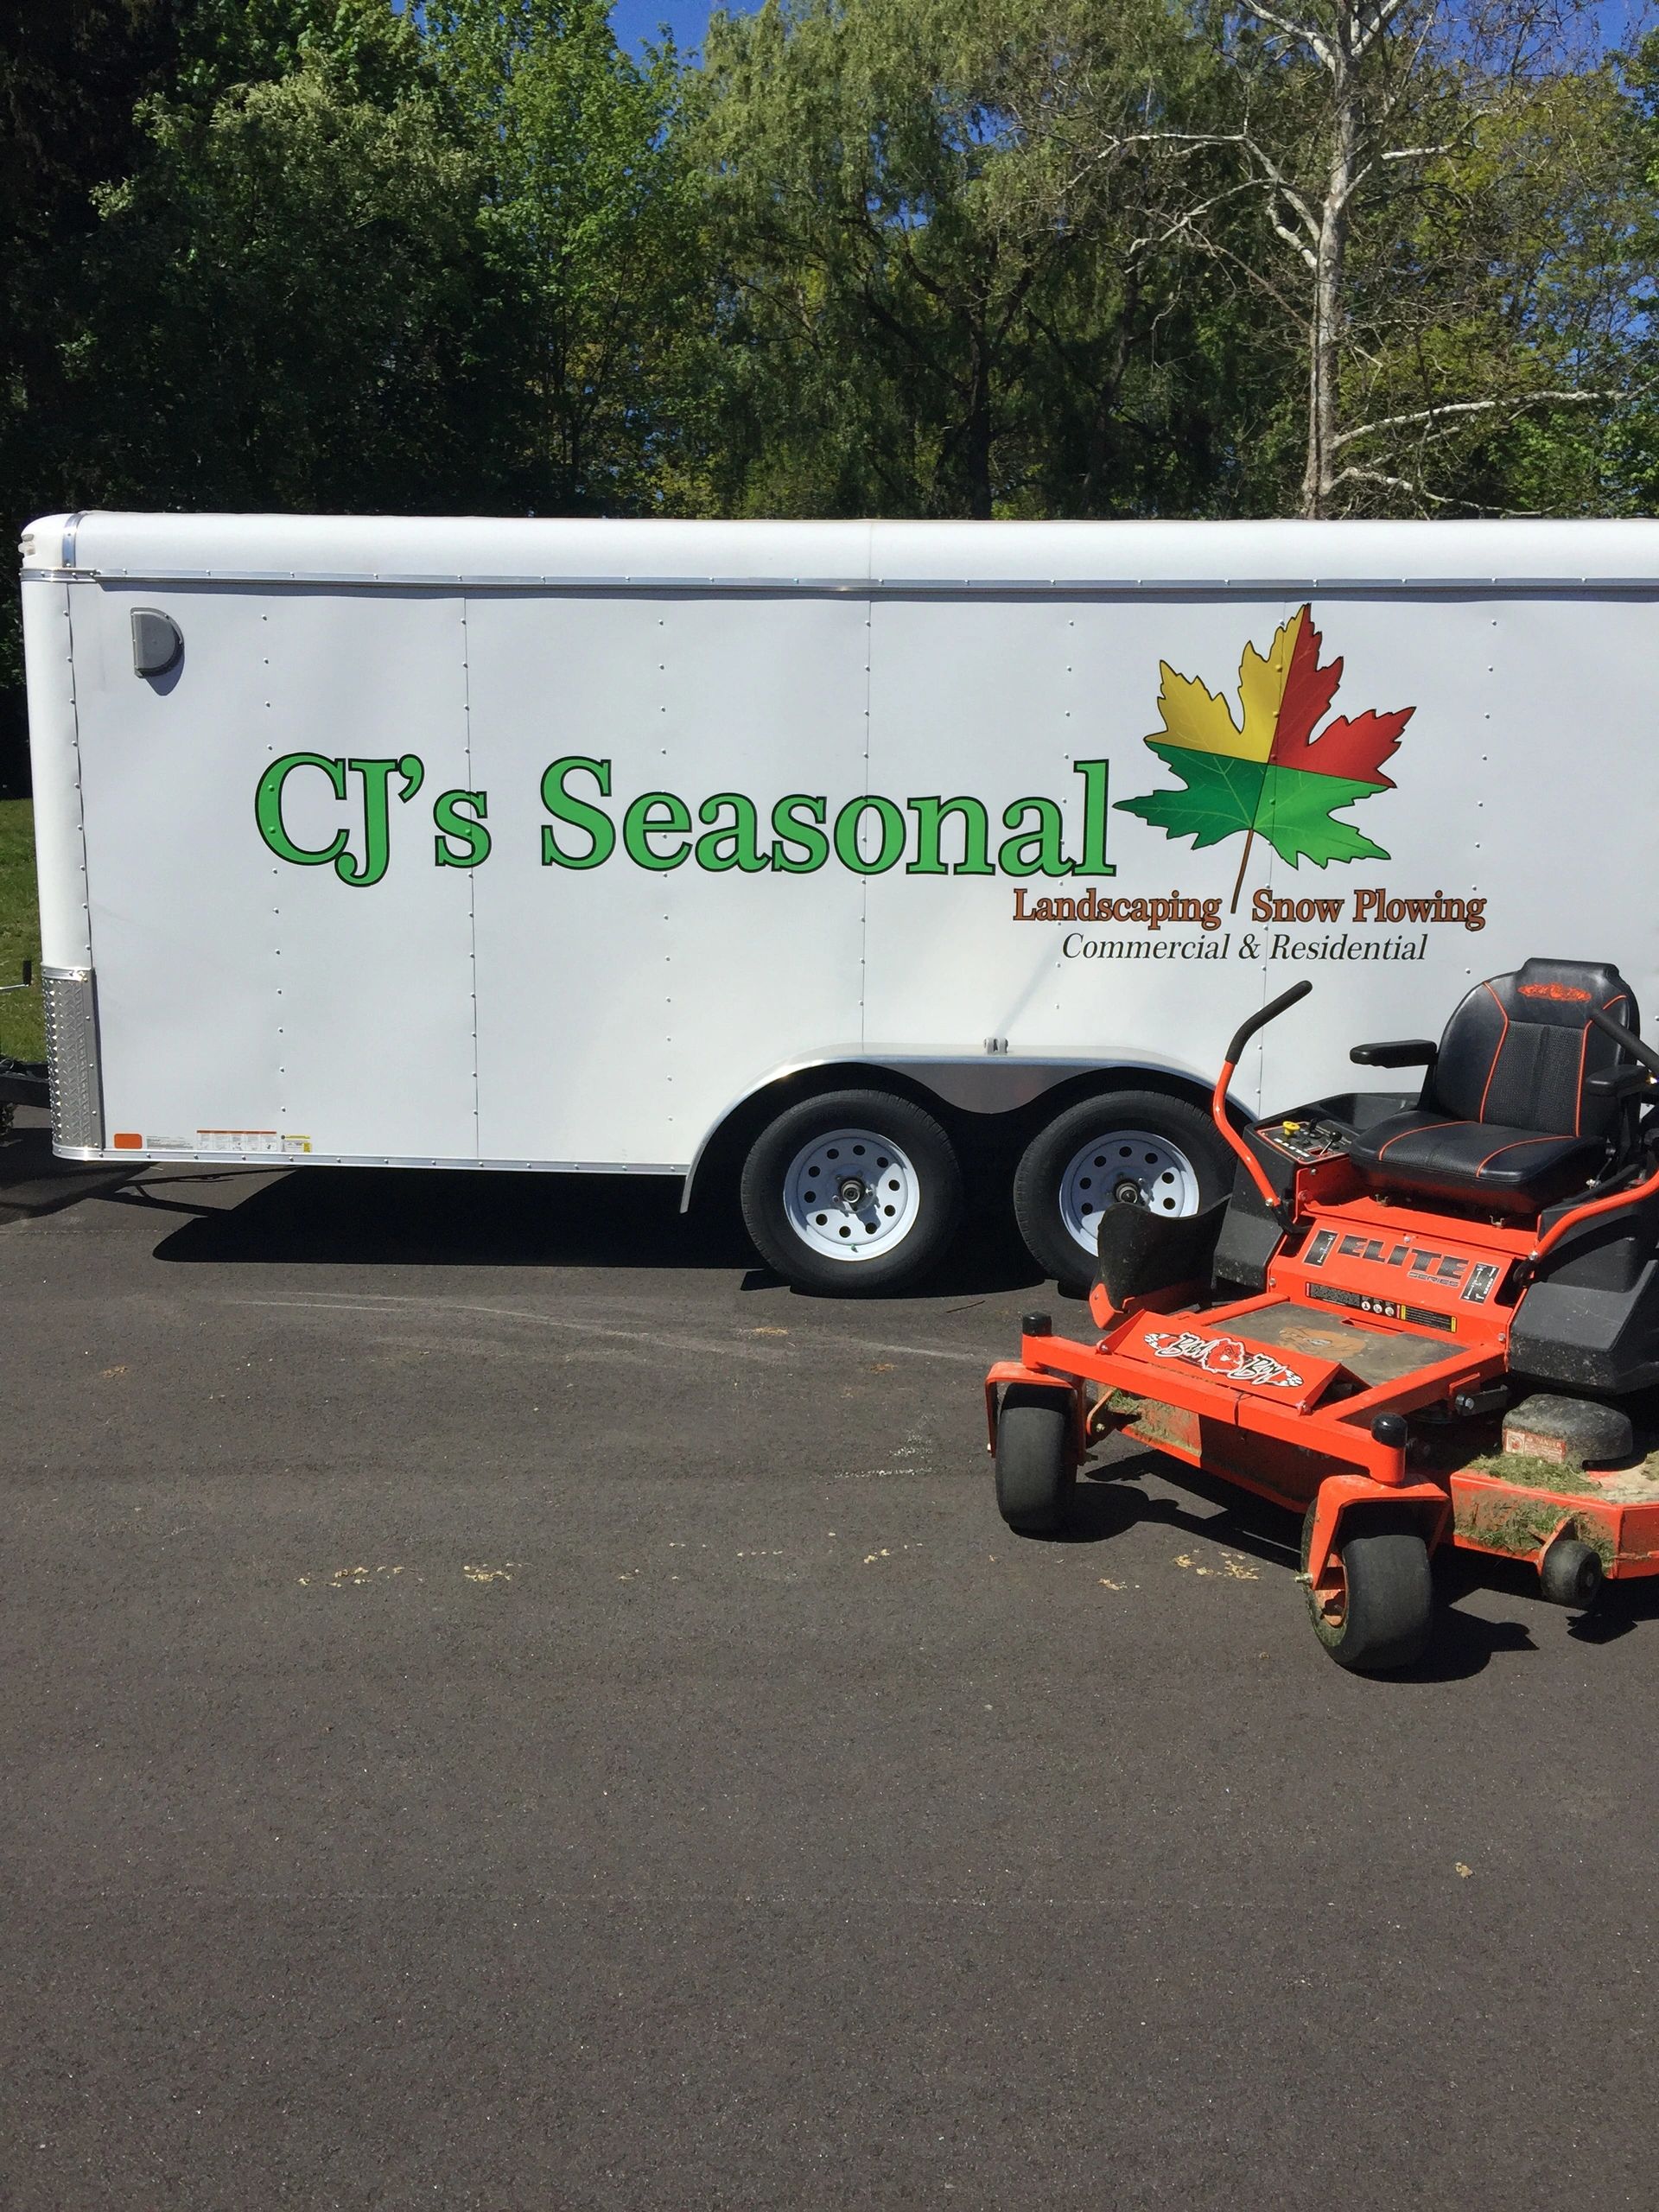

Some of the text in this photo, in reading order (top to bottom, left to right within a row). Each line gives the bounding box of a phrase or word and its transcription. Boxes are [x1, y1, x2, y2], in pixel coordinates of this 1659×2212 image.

[255, 753, 1116, 887] CJ's Seasonal
[1013, 888, 1223, 931] Landscaping
[1251, 889, 1486, 931] Snow Plowing
[1062, 933, 1428, 961] Commercial & Residential
[1338, 1234, 1469, 1280] ELITE
